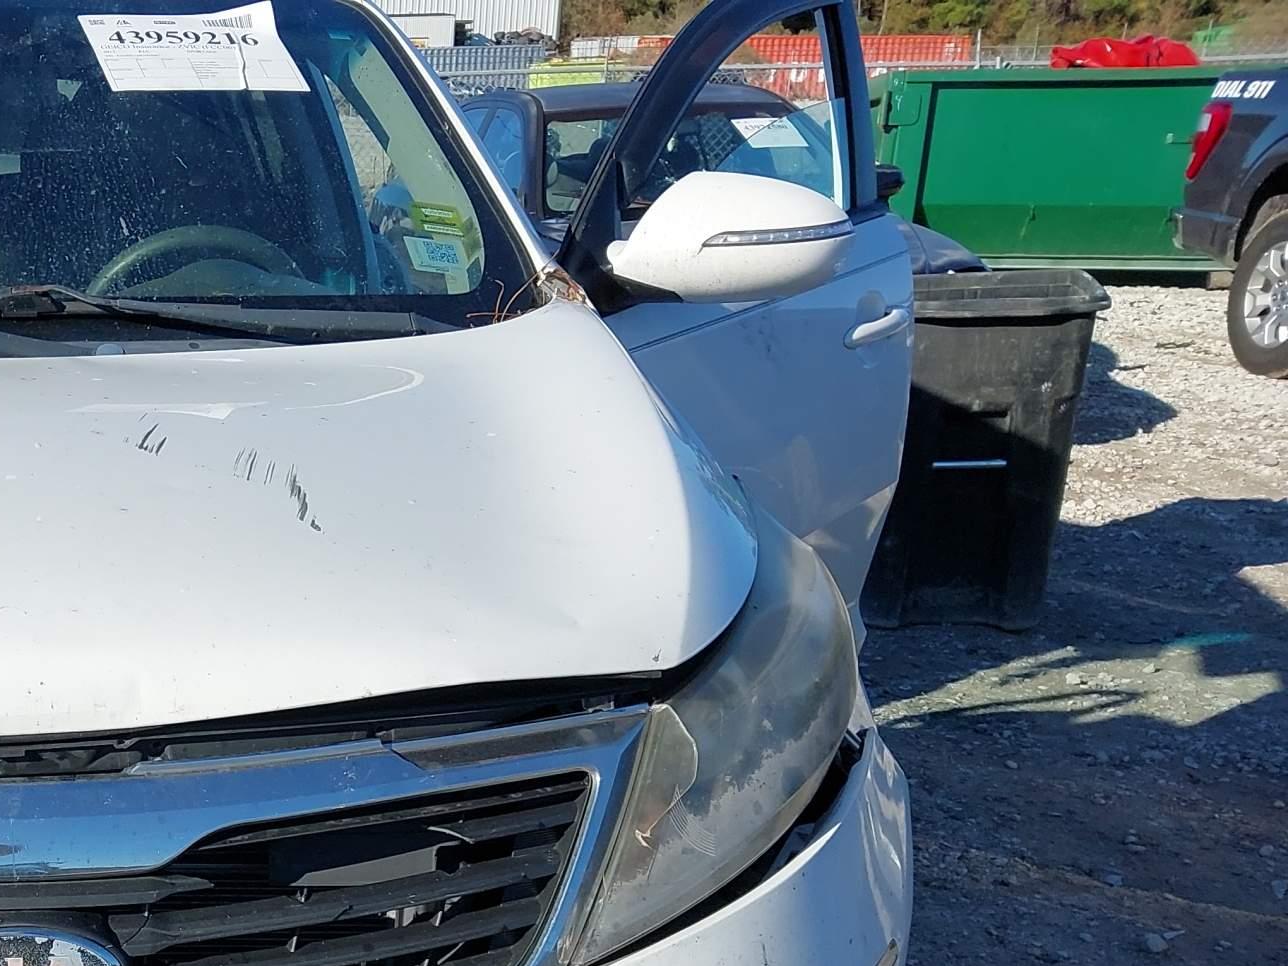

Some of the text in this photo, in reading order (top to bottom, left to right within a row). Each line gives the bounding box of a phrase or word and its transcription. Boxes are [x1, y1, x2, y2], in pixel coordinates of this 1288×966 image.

[109, 30, 259, 46] 43959216
[1211, 80, 1276, 99] DIAL 911
